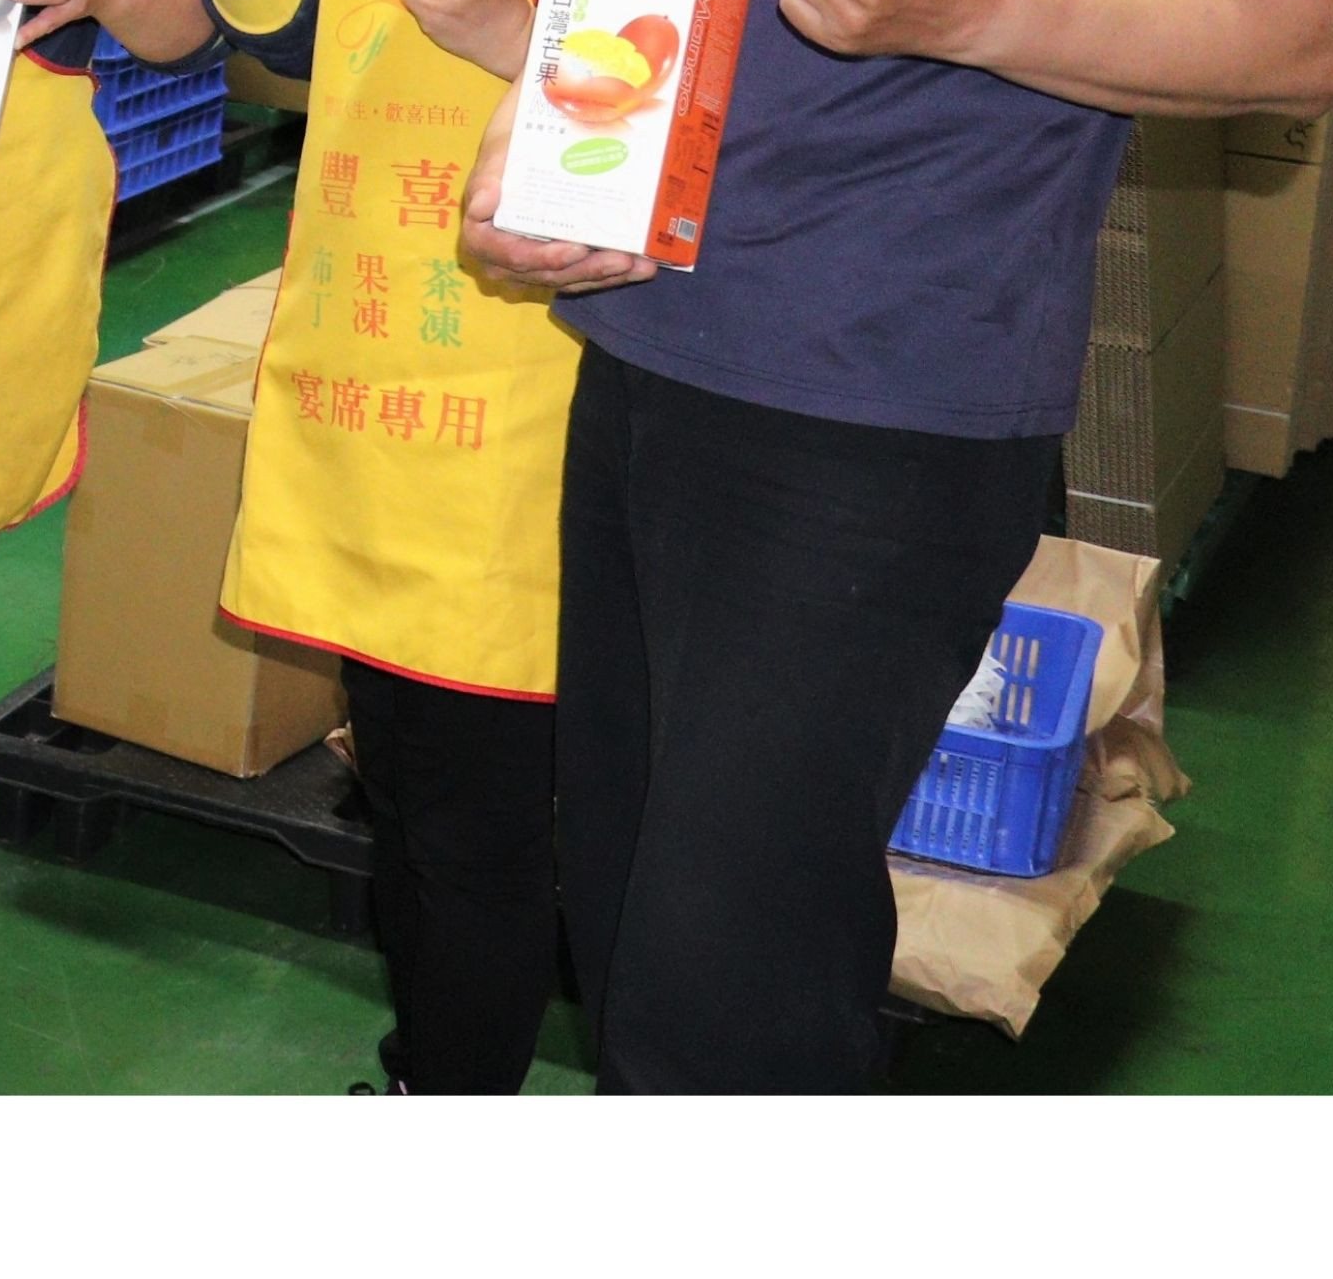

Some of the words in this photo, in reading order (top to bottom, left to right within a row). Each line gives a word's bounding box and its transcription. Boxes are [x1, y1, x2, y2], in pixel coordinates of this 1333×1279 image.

[317, 150, 462, 231] 豐喜
[308, 245, 333, 330] 布丁
[352, 252, 389, 340] 果凍
[418, 257, 467, 349] 茶凍
[291, 368, 487, 452] 宴席專用
